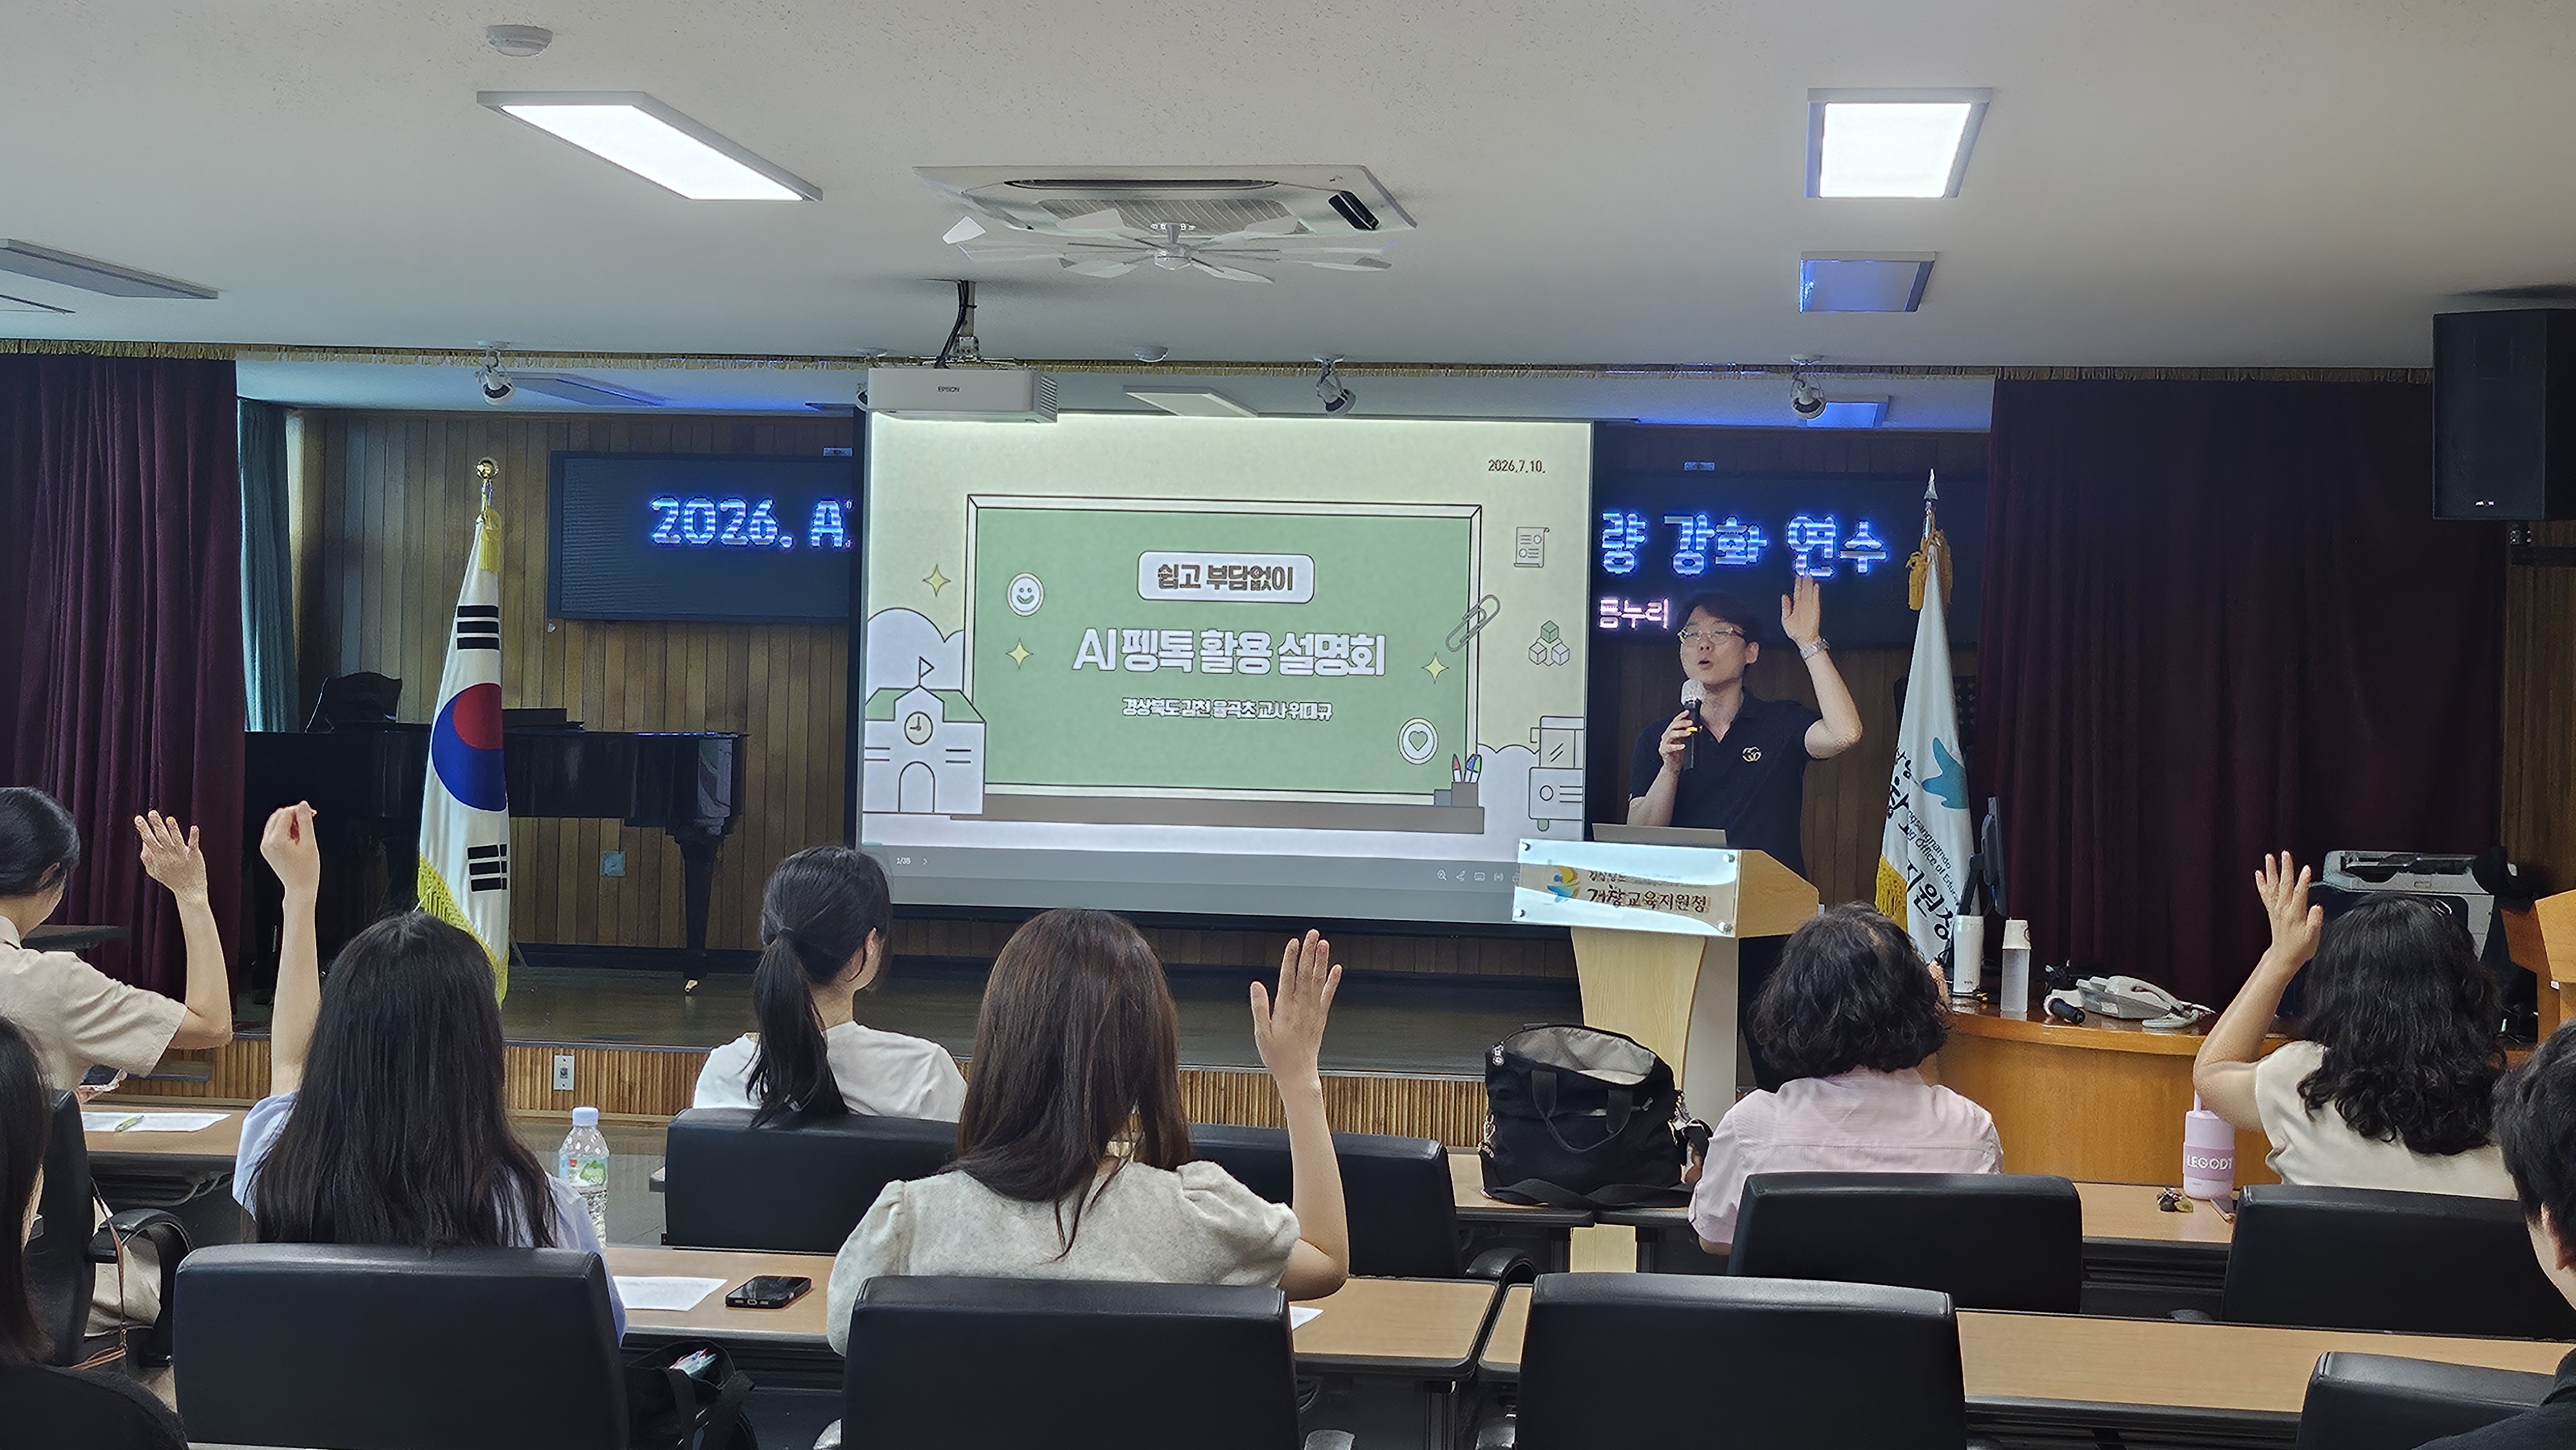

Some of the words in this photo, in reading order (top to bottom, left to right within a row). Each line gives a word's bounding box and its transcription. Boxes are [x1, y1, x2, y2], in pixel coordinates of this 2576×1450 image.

[1488, 459, 1546, 473] 2026.7.10.
[650, 496, 794, 549] 2026.
[810, 499, 853, 549] A
[1663, 514, 1768, 576] 강화
[1786, 514, 1887, 578] 연수
[1158, 564, 1201, 590] 쉽고
[1206, 565, 1294, 591] 부담없이
[1199, 628, 1274, 675] 활용
[1278, 632, 1387, 677] 설명회
[1256, 701, 1288, 720] 교사
[1289, 701, 1334, 721] 위대규
